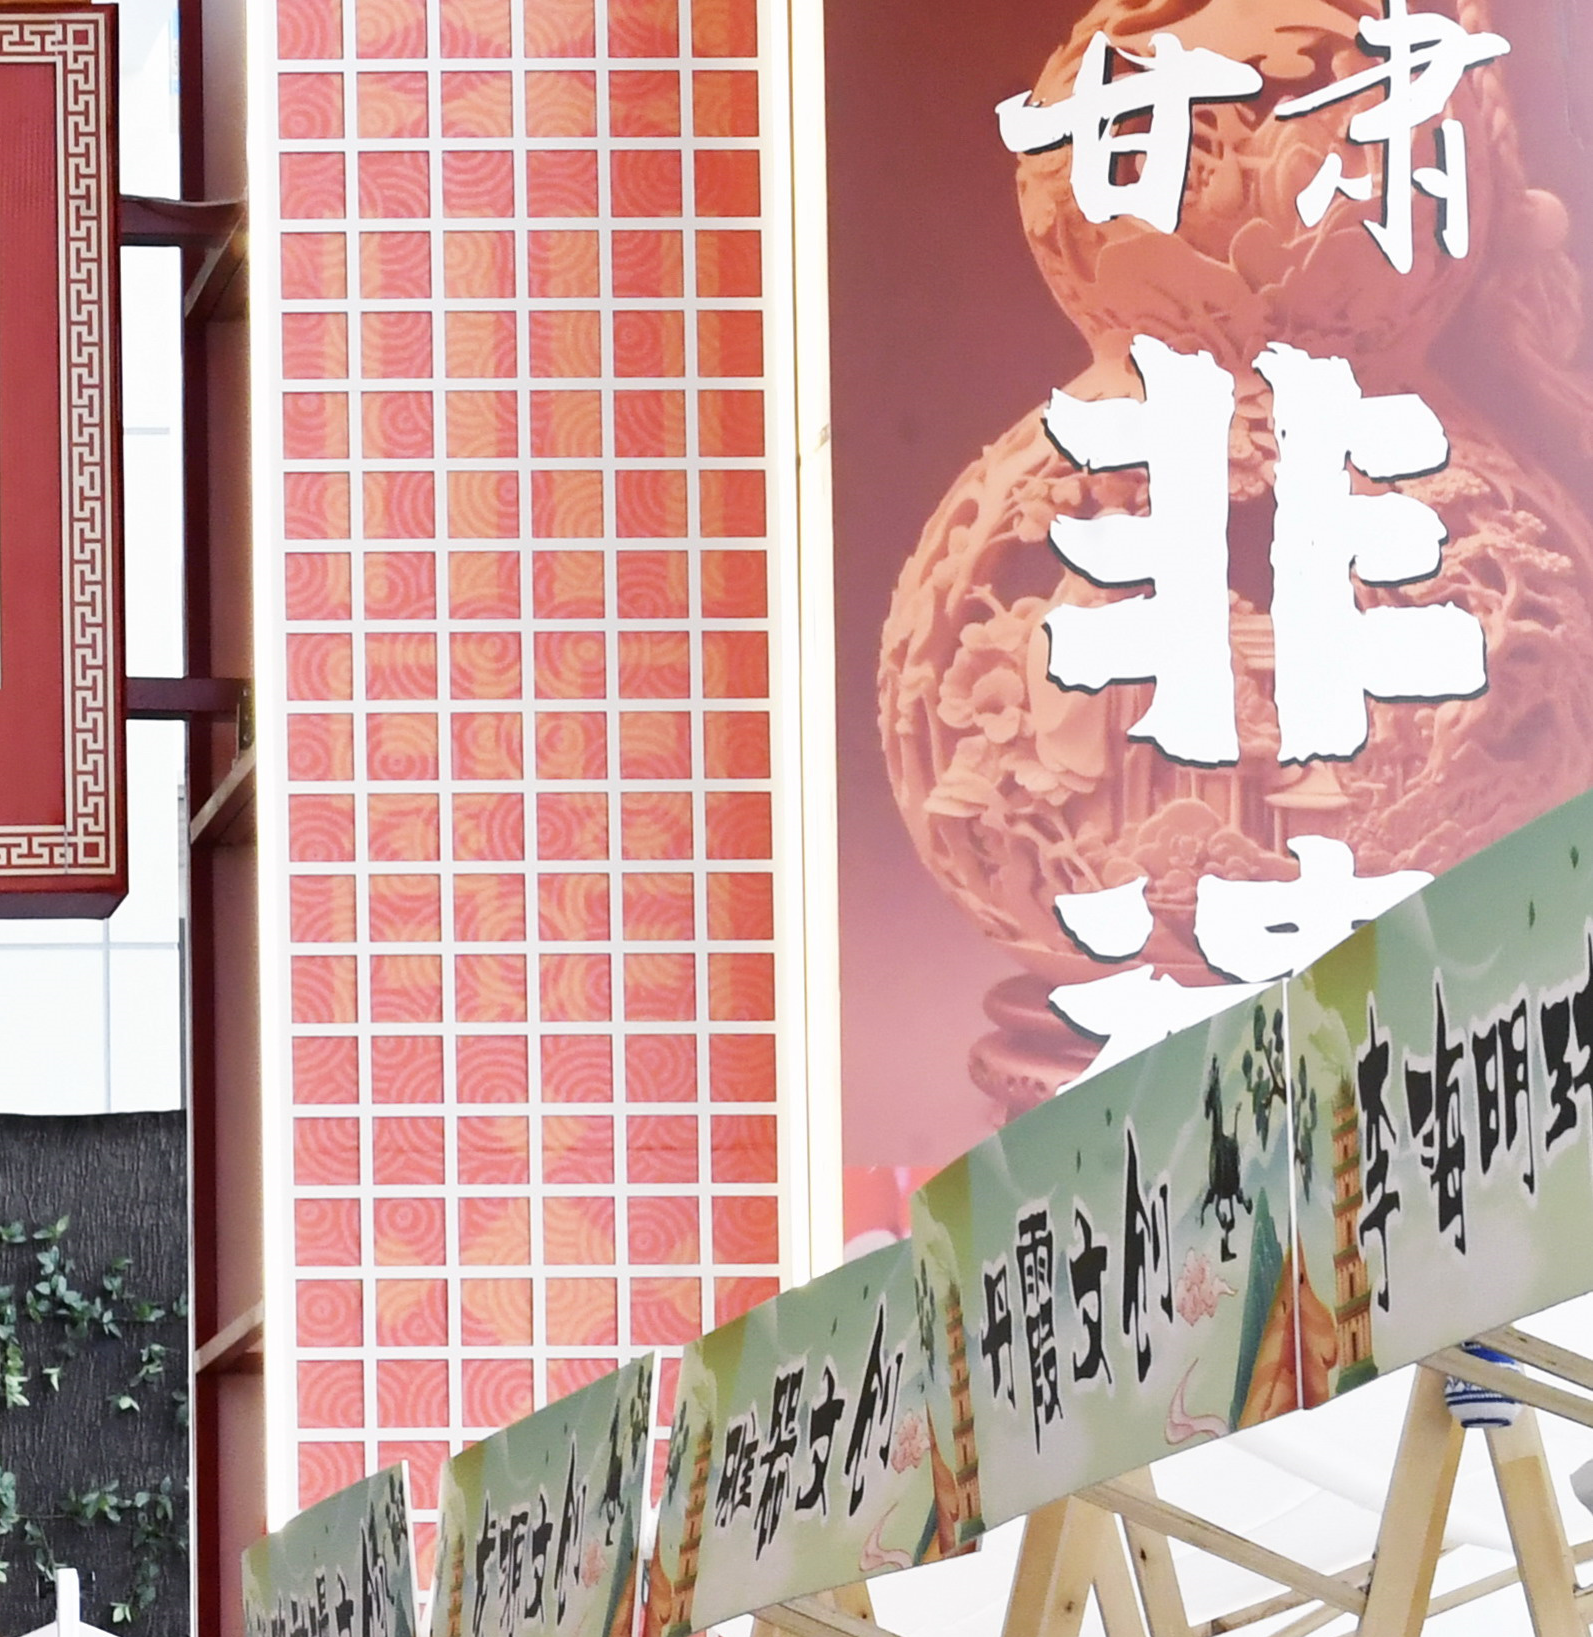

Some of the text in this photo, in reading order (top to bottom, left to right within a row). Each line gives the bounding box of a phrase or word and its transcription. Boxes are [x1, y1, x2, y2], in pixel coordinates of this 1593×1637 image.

[996, 0, 1511, 275] 甘肃
[979, 1117, 1174, 1456] 丹霞文创
